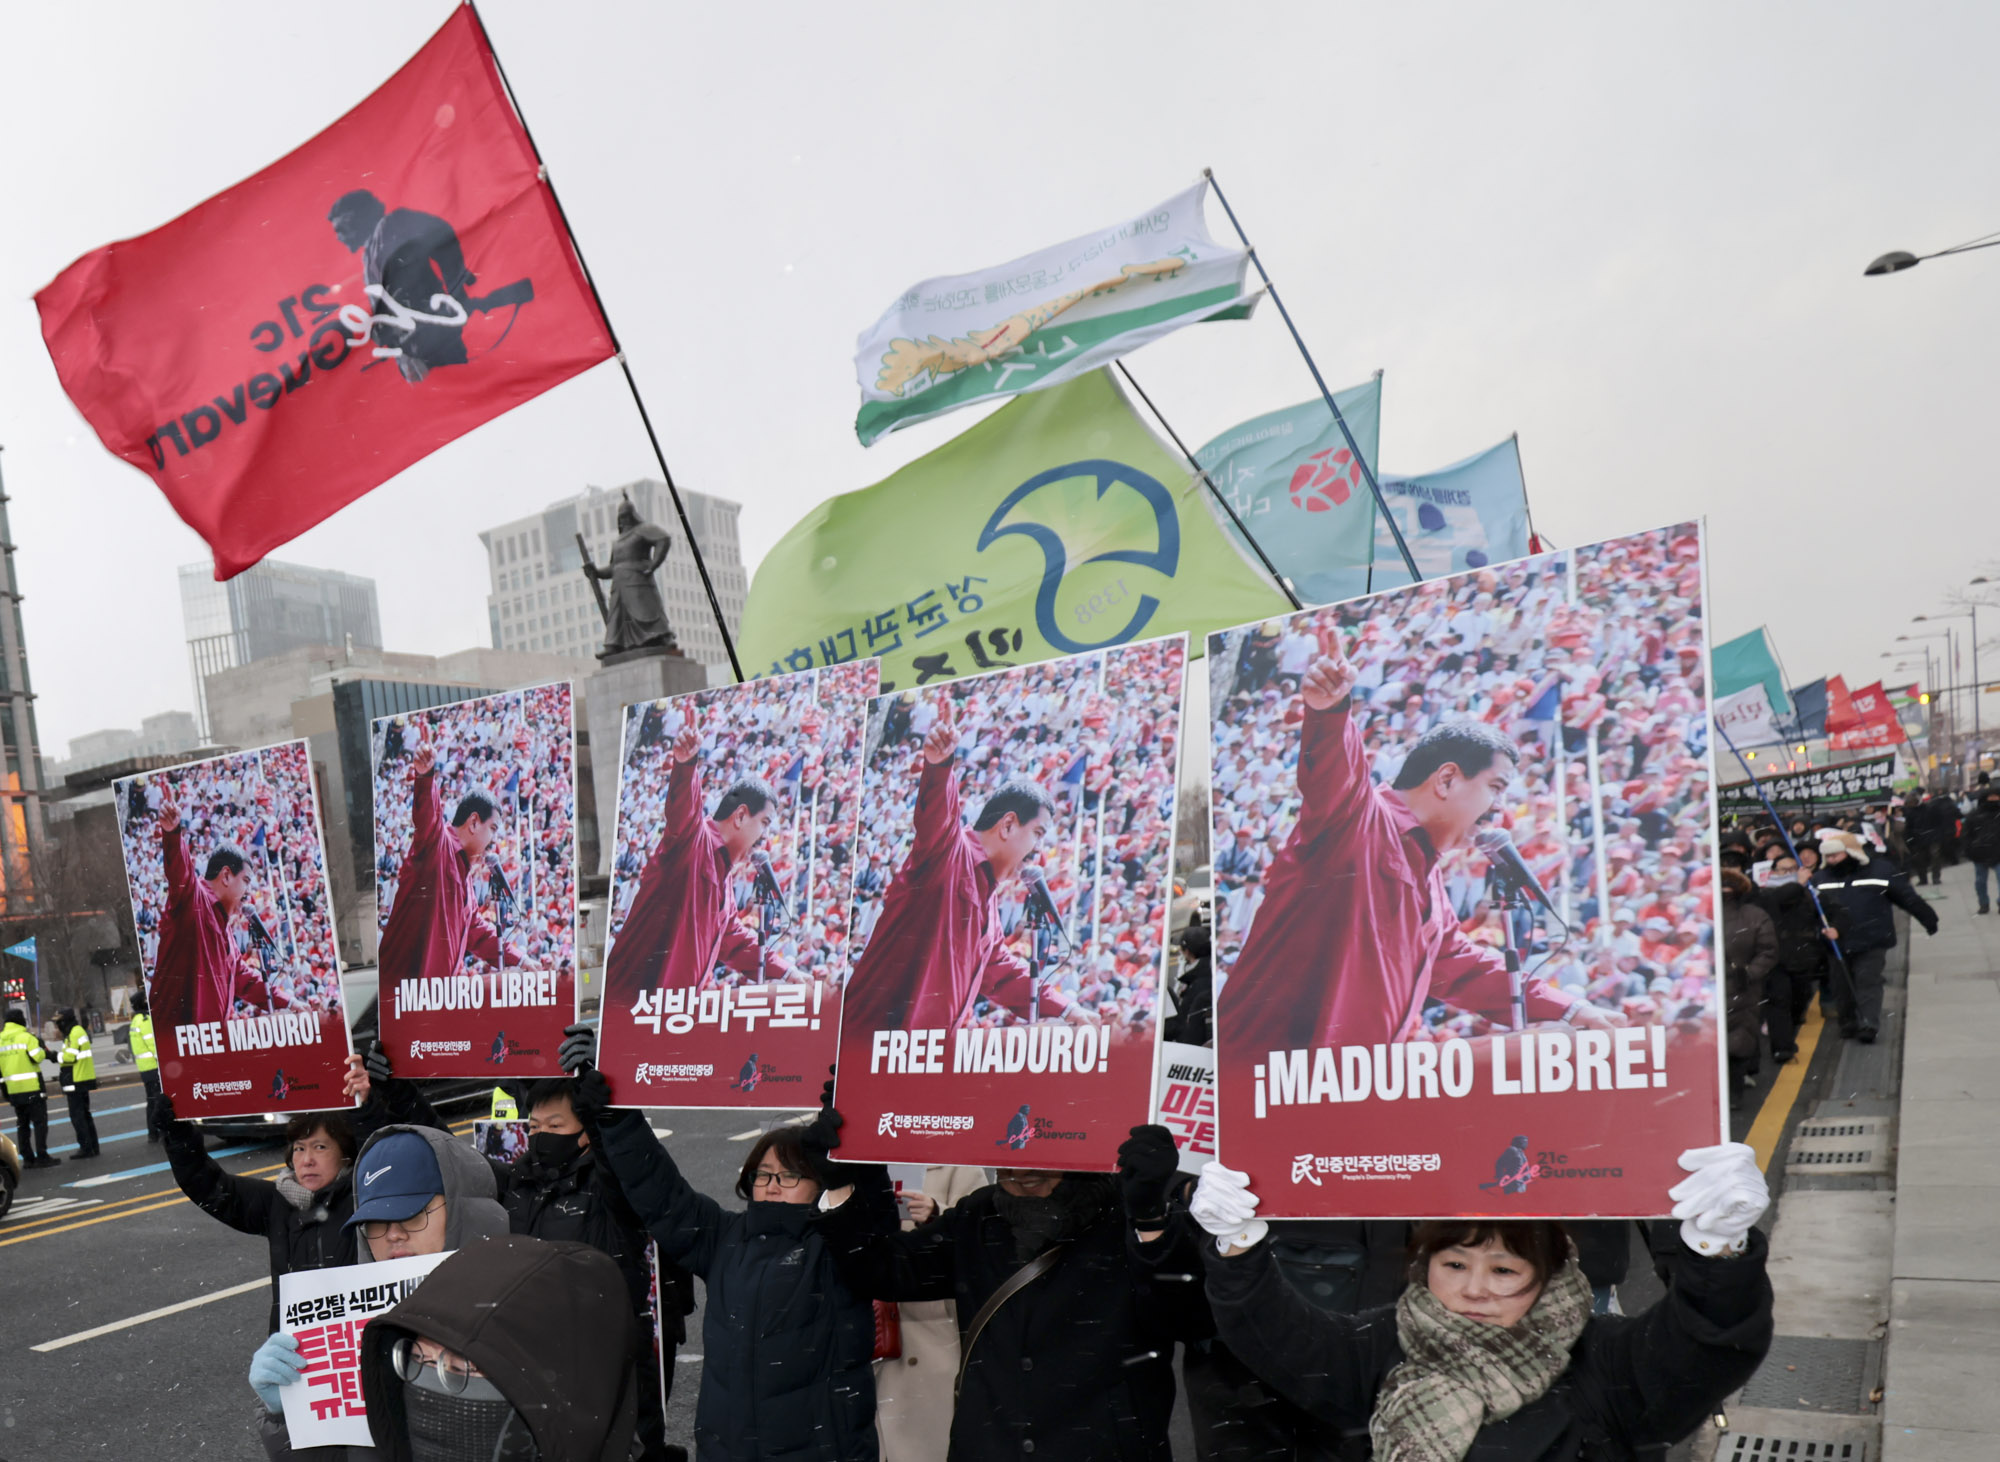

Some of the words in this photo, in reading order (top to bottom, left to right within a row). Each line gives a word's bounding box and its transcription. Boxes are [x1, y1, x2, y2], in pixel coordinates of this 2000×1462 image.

[394, 974, 484, 1020] ¡MADURO
[490, 970, 557, 1009] LIBRE!
[630, 980, 822, 1034] 석방마두로!
[175, 1022, 225, 1056] FREE
[227, 1011, 322, 1052] MADURO!
[870, 1029, 946, 1074] FREE
[953, 1024, 1110, 1073] MADURO!
[1254, 1038, 1475, 1119] ¡MADURO
[1492, 1025, 1668, 1096] LIBRE!
[1315, 1153, 1441, 1173] 민중민주당(민중당)
[1537, 1151, 1568, 1165] 21c
[1538, 1165, 1623, 1179] Guevara
[286, 1293, 346, 1326] 석유강탈
